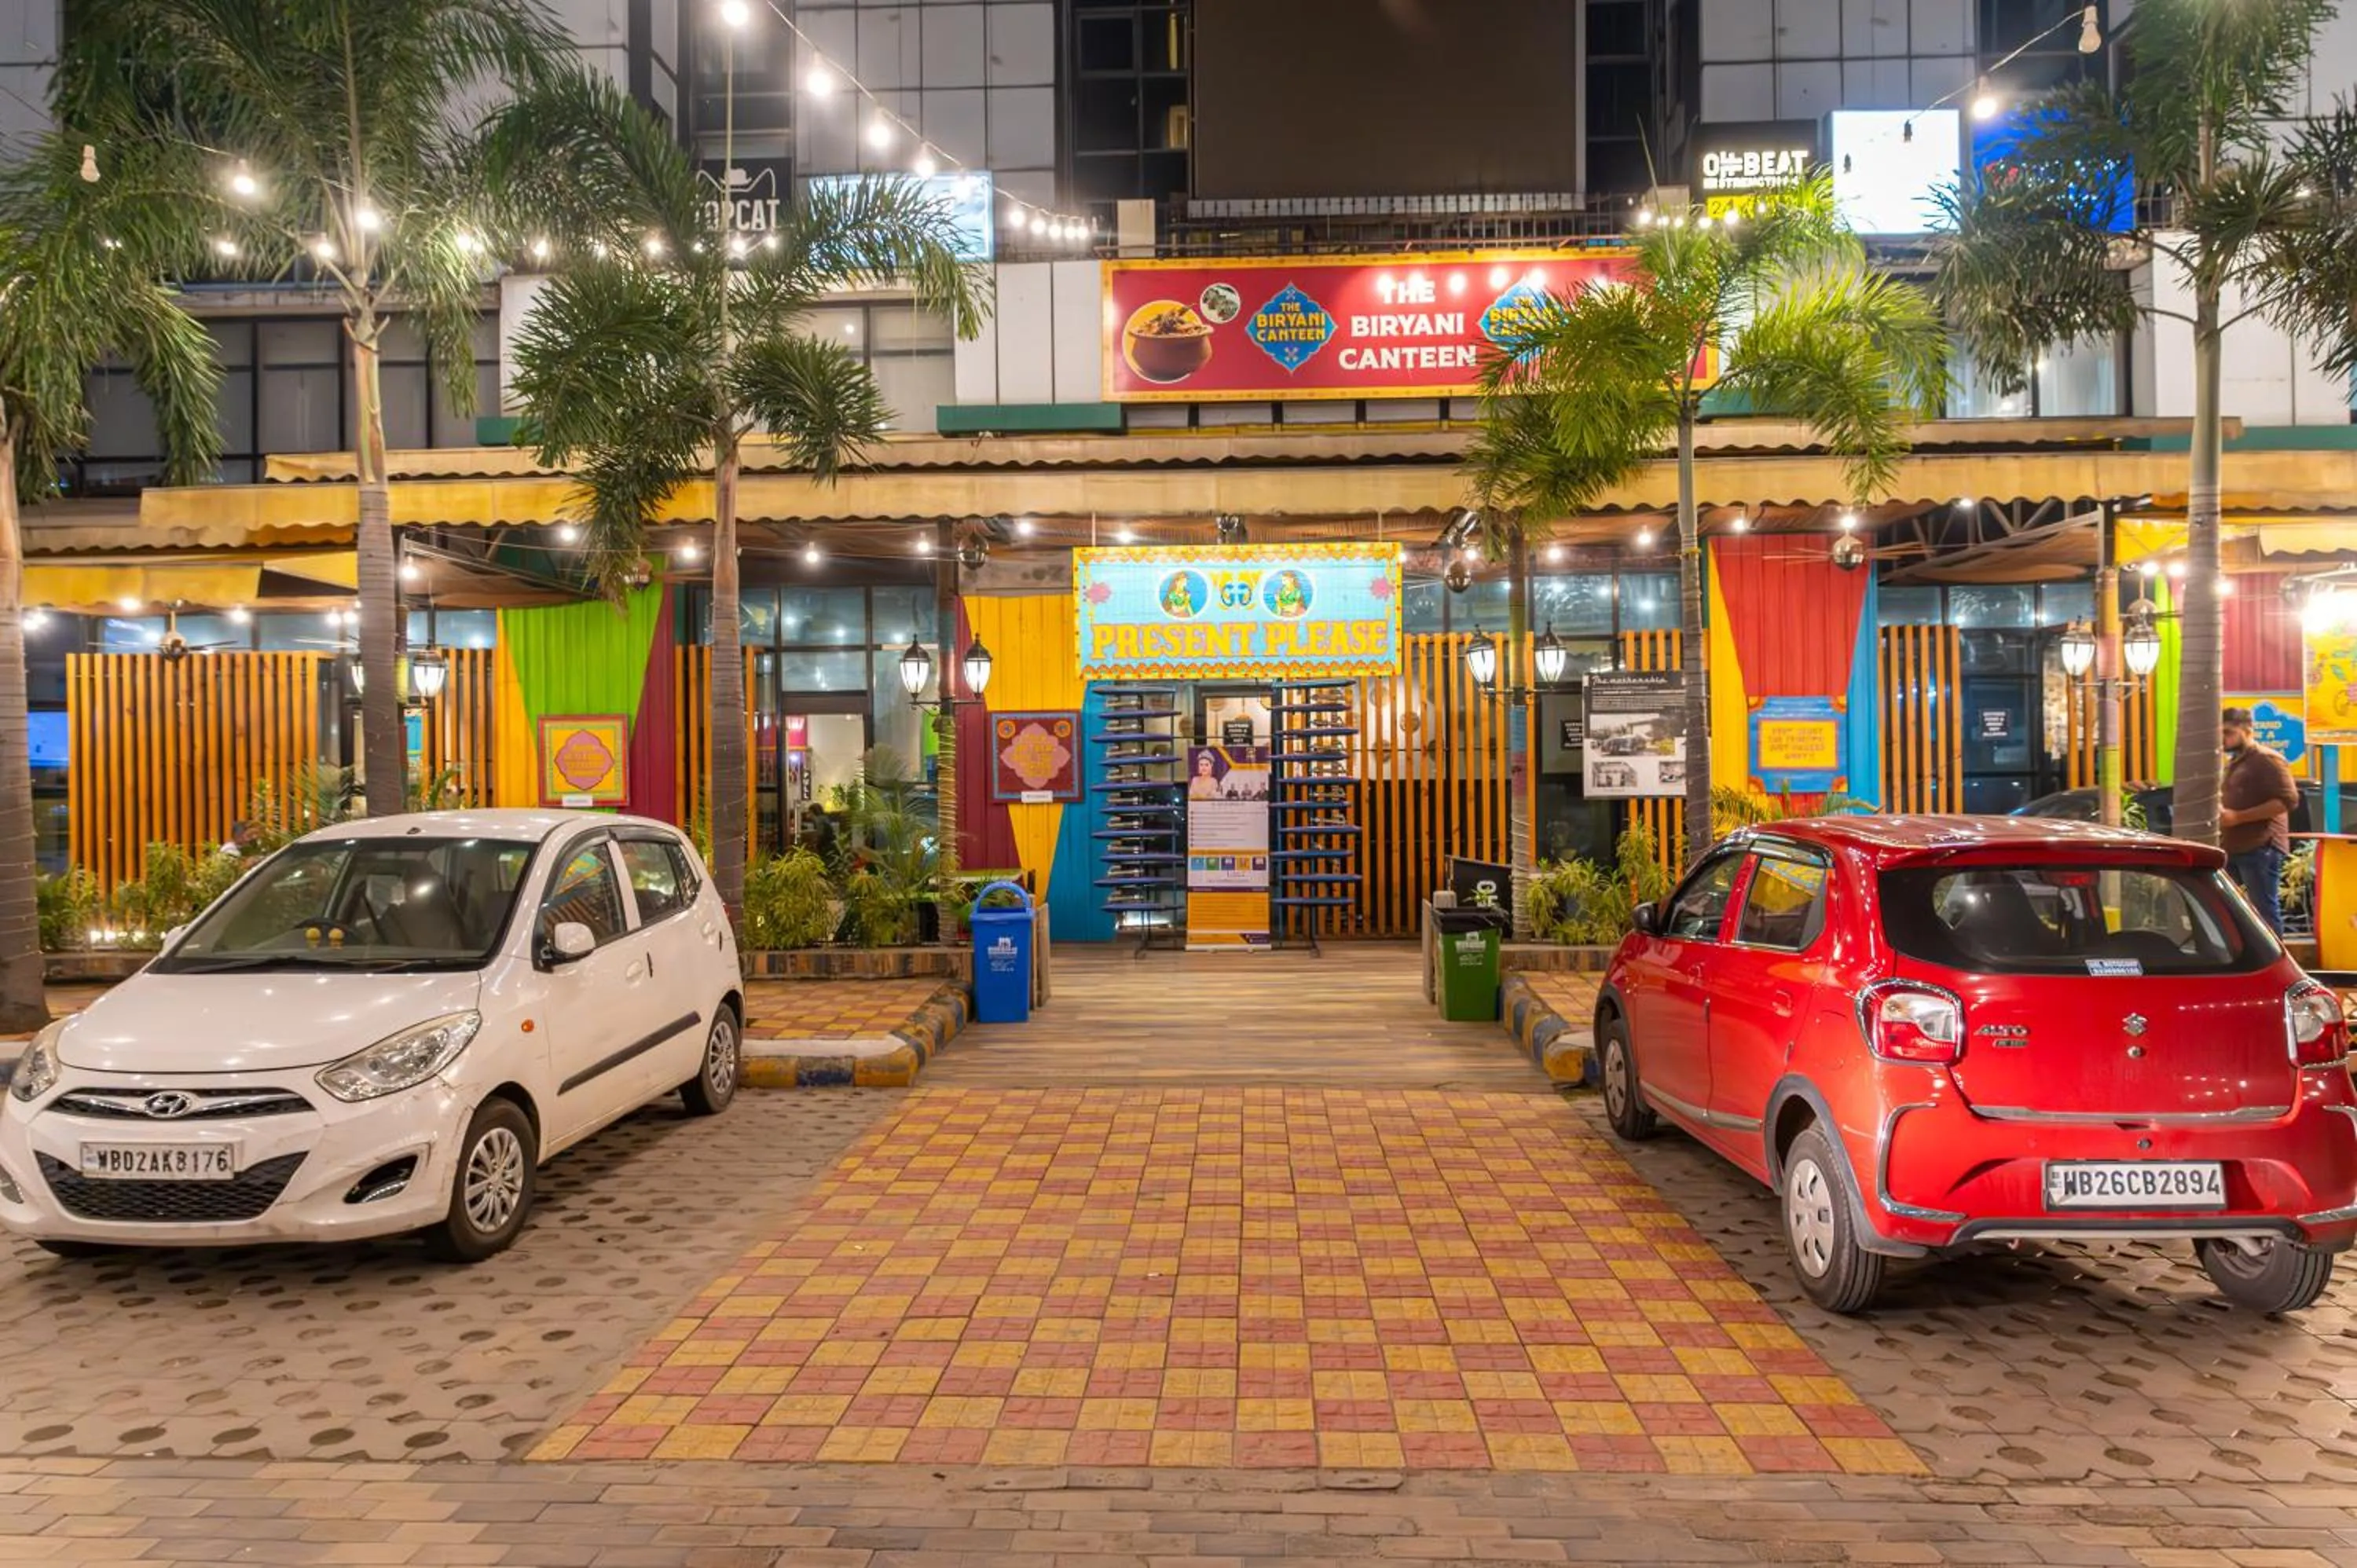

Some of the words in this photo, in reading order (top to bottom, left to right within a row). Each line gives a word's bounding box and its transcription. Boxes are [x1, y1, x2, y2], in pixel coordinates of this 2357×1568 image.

[692, 199, 780, 232] OPCAT
[1281, 302, 1301, 312] THE
[1257, 313, 1326, 328] BIRYANI
[1351, 313, 1465, 338] BIRYANI
[1257, 328, 1326, 342] CANTEEN
[1338, 345, 1477, 371] CANTEEN
[1091, 621, 1258, 660] PRESENT
[1263, 619, 1389, 657] PLEASE
[97, 1149, 228, 1173] WB02AK8176
[2063, 1170, 2220, 1196] WB26CB2894
